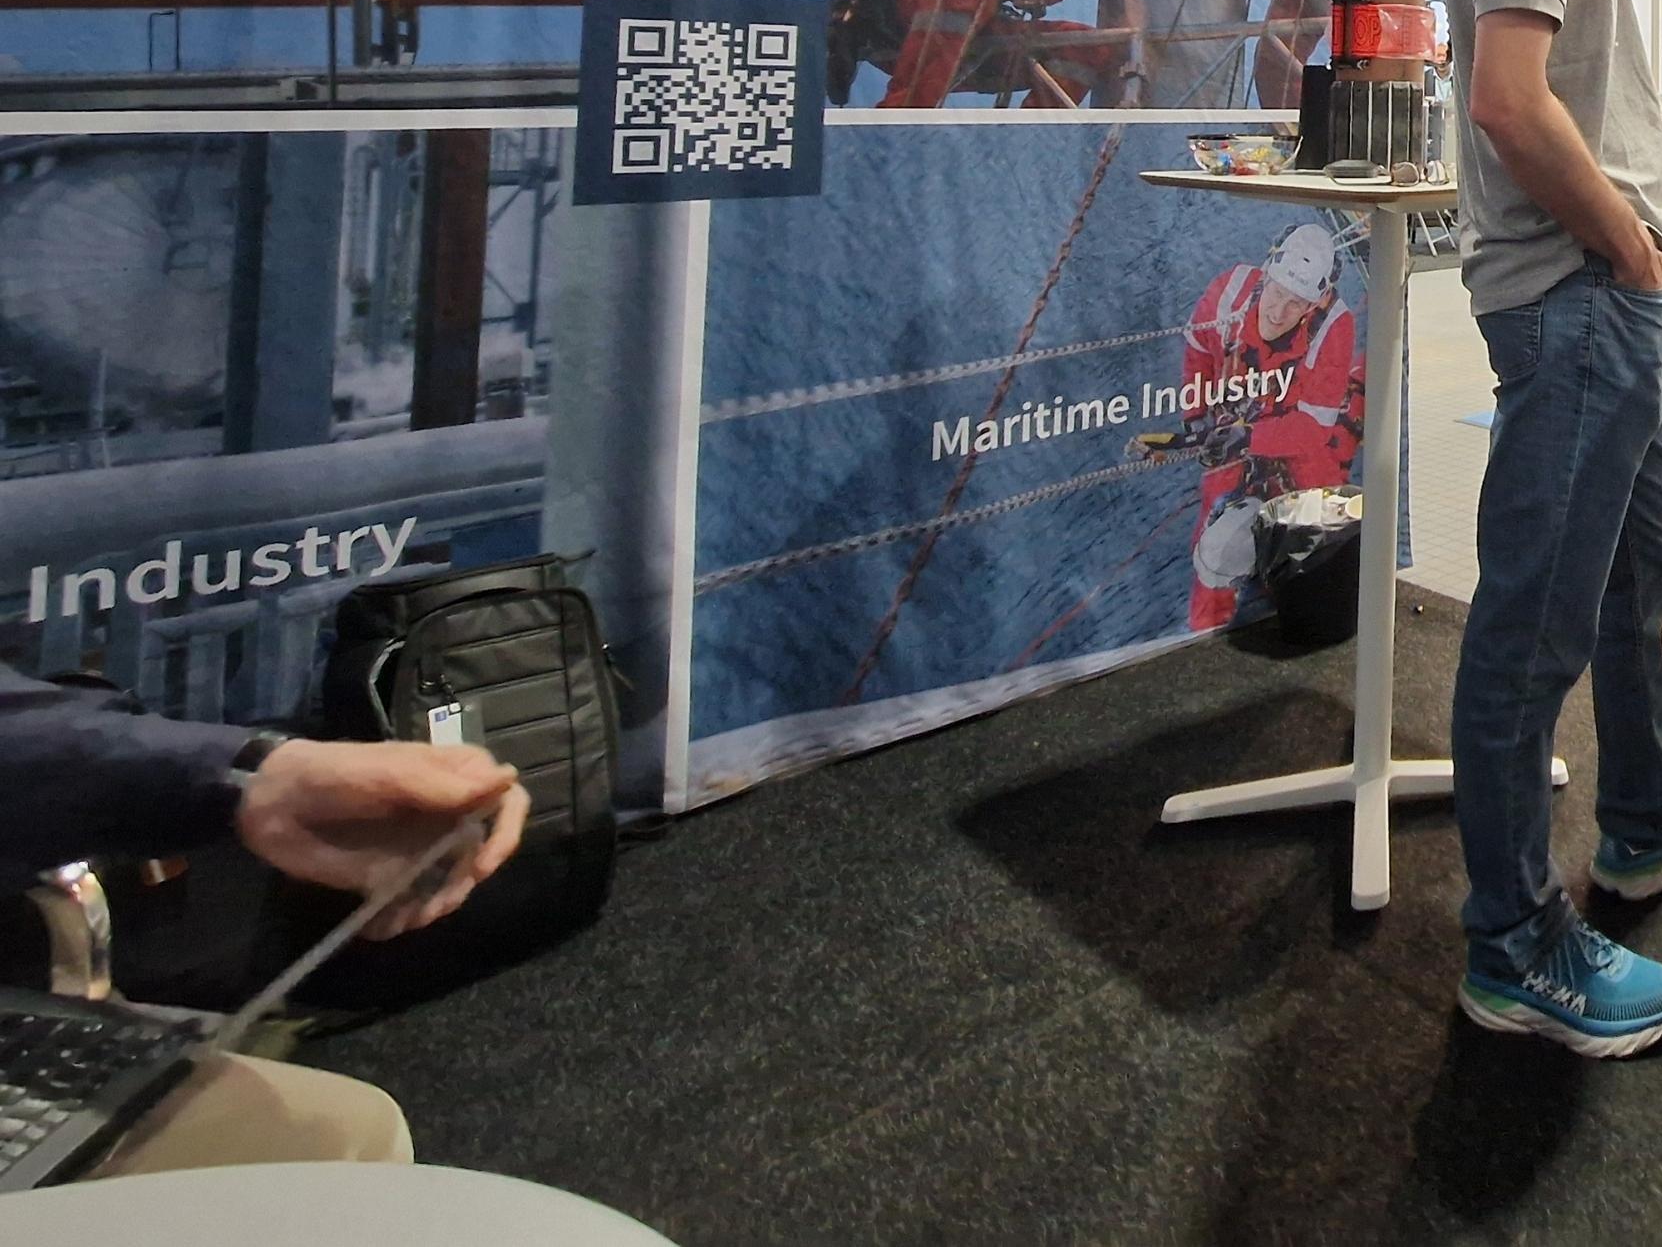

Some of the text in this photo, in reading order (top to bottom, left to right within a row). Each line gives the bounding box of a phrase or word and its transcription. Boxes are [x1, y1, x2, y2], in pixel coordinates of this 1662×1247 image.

[932, 363, 1296, 461] Maritime Industry
[28, 515, 417, 624] Industry
